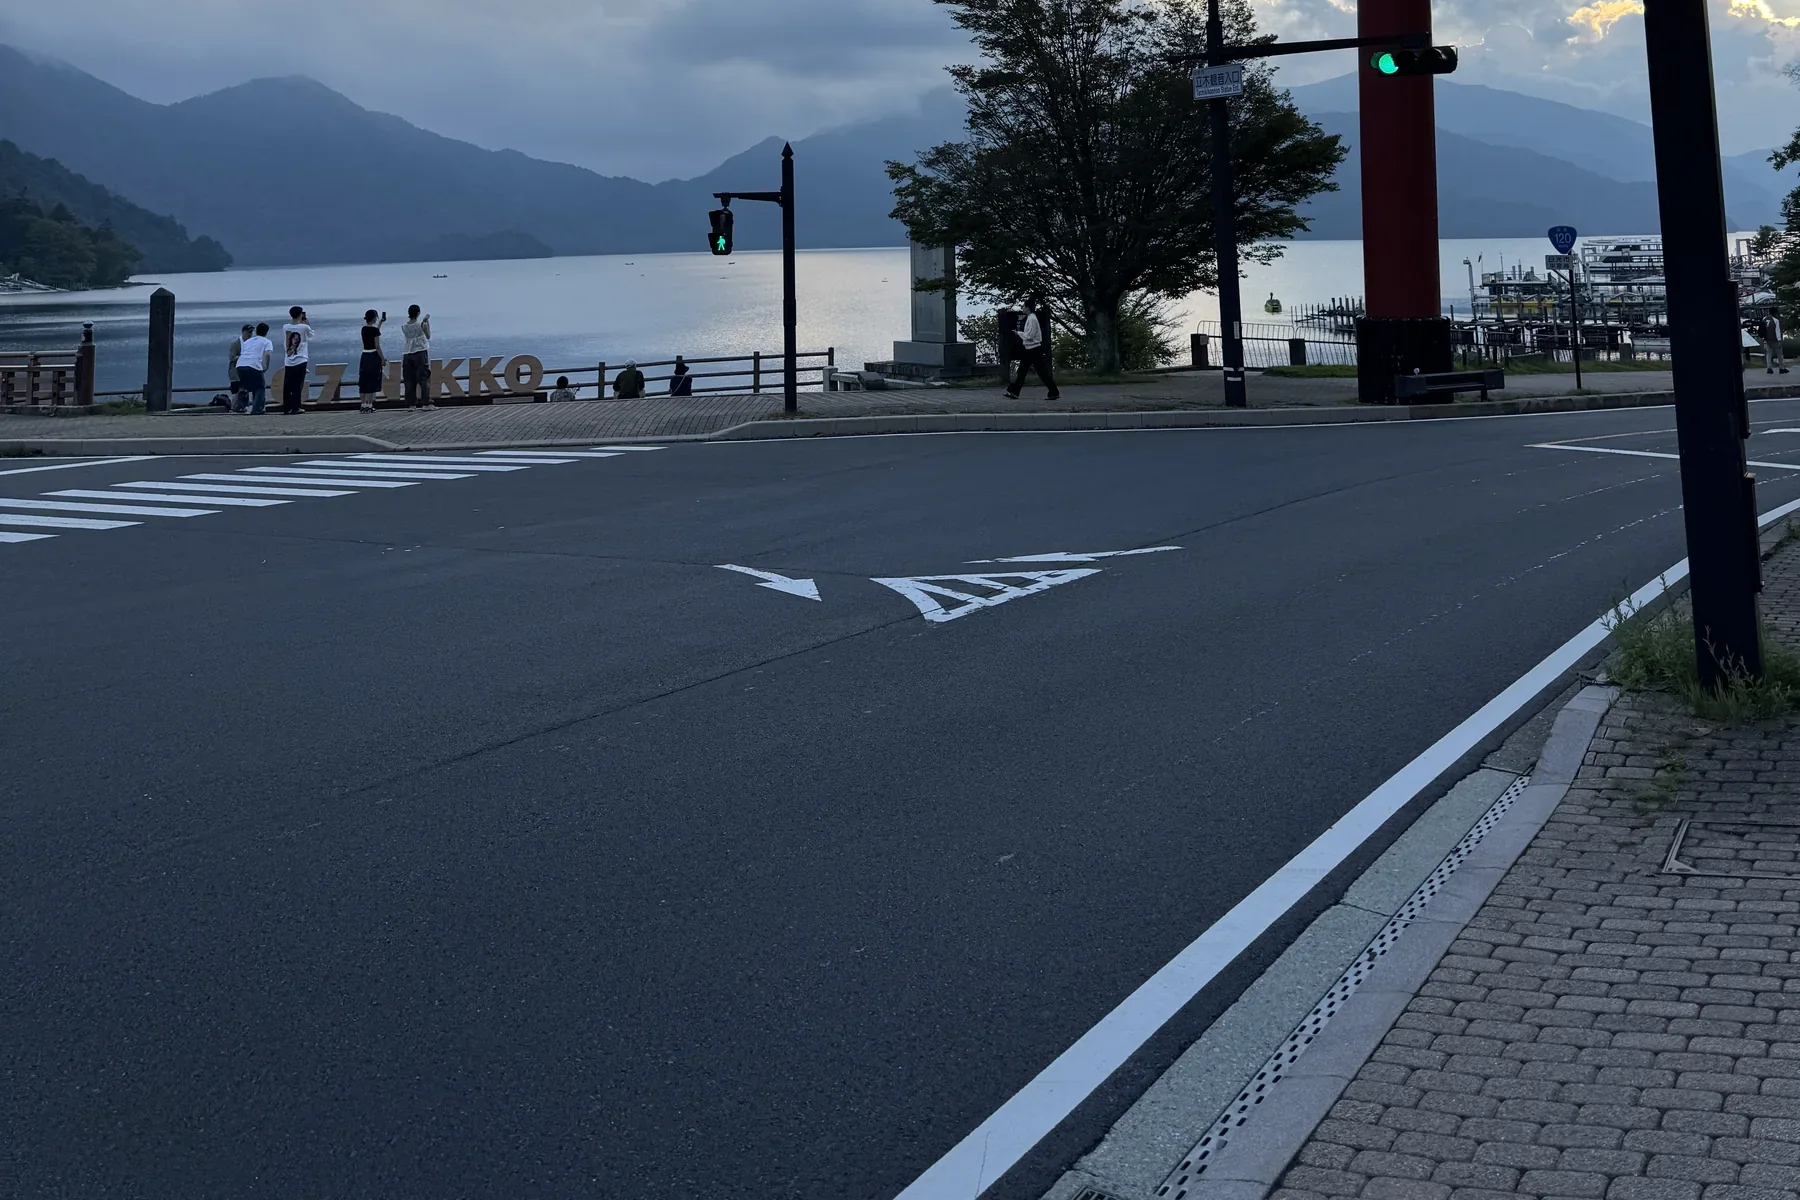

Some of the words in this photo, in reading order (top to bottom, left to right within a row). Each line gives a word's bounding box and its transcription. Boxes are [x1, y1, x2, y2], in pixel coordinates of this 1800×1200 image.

[1195, 71, 1240, 88] 立木観音入口
[1554, 232, 1572, 244] 120
[376, 354, 544, 401] NKKO
